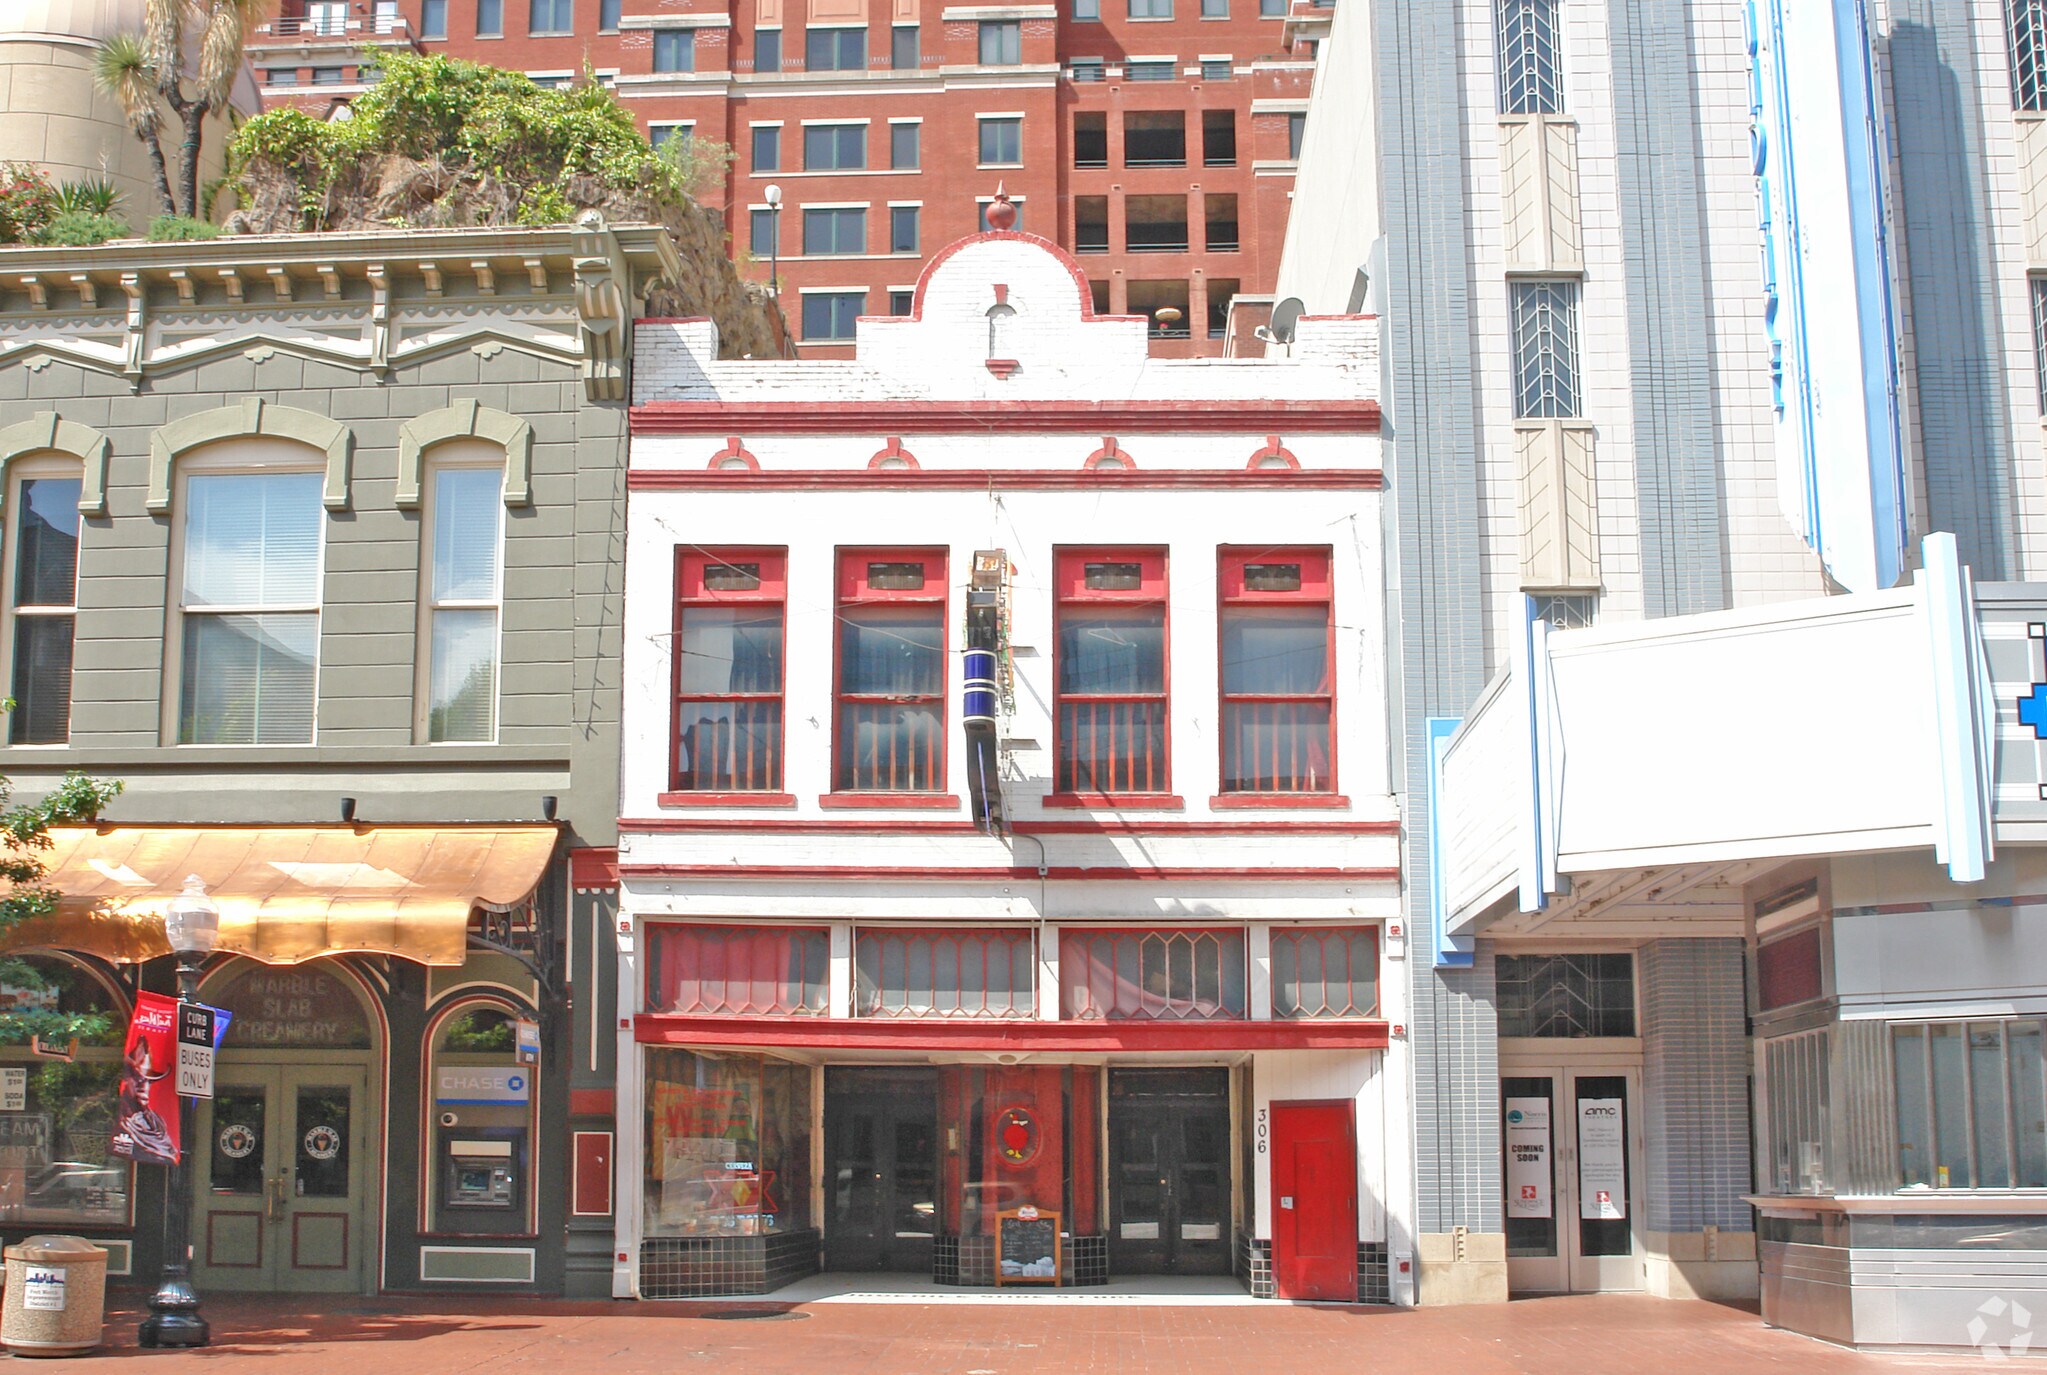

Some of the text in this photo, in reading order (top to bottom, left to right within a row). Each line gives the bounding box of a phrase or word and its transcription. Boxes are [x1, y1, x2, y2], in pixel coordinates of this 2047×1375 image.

[263, 998, 311, 1018] SLAB
[186, 1012, 208, 1026] CURB
[186, 1027, 207, 1041] LANE
[181, 1049, 211, 1068] BUSES
[182, 1071, 209, 1089] ONLY
[441, 1077, 504, 1089] CHASE
[1257, 1108, 1267, 1153] 306
[1511, 1144, 1545, 1153] COMING
[1517, 1154, 1540, 1162] SOON
